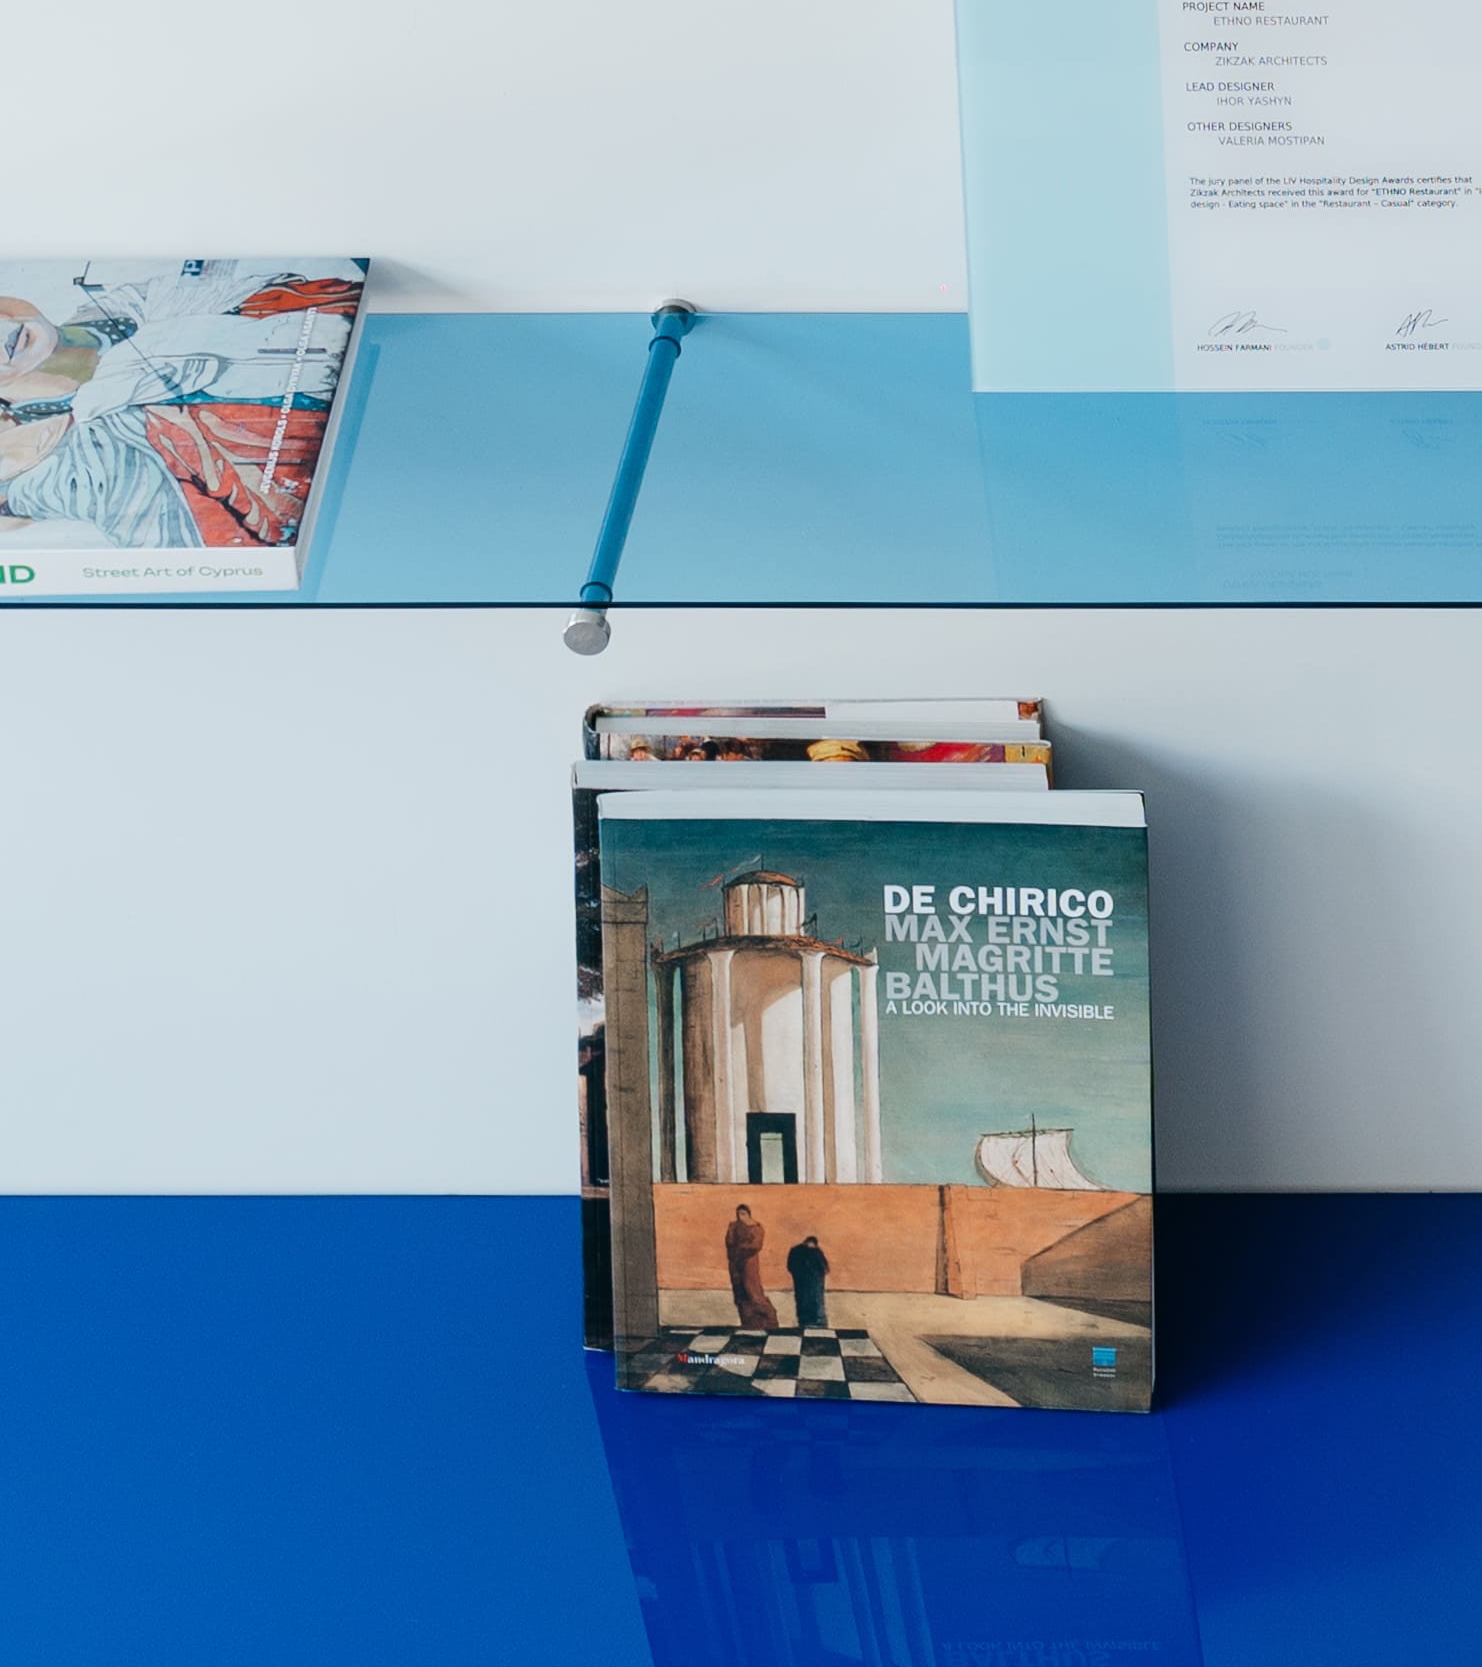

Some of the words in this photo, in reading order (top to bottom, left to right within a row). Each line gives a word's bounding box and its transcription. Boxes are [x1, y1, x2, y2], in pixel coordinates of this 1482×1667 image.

[1182, 1, 1230, 13] PROJECT
[1233, 1, 1265, 11] NAME
[1213, 15, 1253, 27] ETHNO
[1255, 15, 1329, 26] RESTAURANT
[1183, 41, 1239, 52] COMPANY
[1215, 56, 1255, 67] ZIKZAK
[1258, 55, 1328, 67] ARCHITECTS
[1185, 81, 1215, 92] LEAD
[1218, 81, 1275, 92] DESIGNER
[1216, 96, 1245, 107] IHOR
[1247, 96, 1292, 107] YASHYN
[1187, 121, 1226, 132] OTHER
[1229, 121, 1293, 132] DESIGNERS
[1218, 135, 1265, 146] VALERIA
[1267, 135, 1325, 146] MOSTIPAN
[1229, 178, 1252, 186] panel
[1349, 177, 1379, 186] Design
[83, 567, 138, 578] Street
[143, 567, 172, 577] Art
[176, 567, 194, 576] of
[199, 566, 262, 577] Cyprus
[884, 885, 935, 914] DE
[949, 886, 1114, 918] CHIRICO
[885, 915, 973, 943] MAX
[988, 916, 1113, 946] ERNST
[916, 944, 1114, 976] MAGRITTE
[886, 972, 1059, 1003] BALTHUS
[886, 1001, 897, 1014] A
[903, 1001, 948, 1015] LOOK
[954, 1002, 991, 1016] INTO
[997, 1003, 1029, 1017] THE
[1036, 1004, 1114, 1020] INVISIBLE
